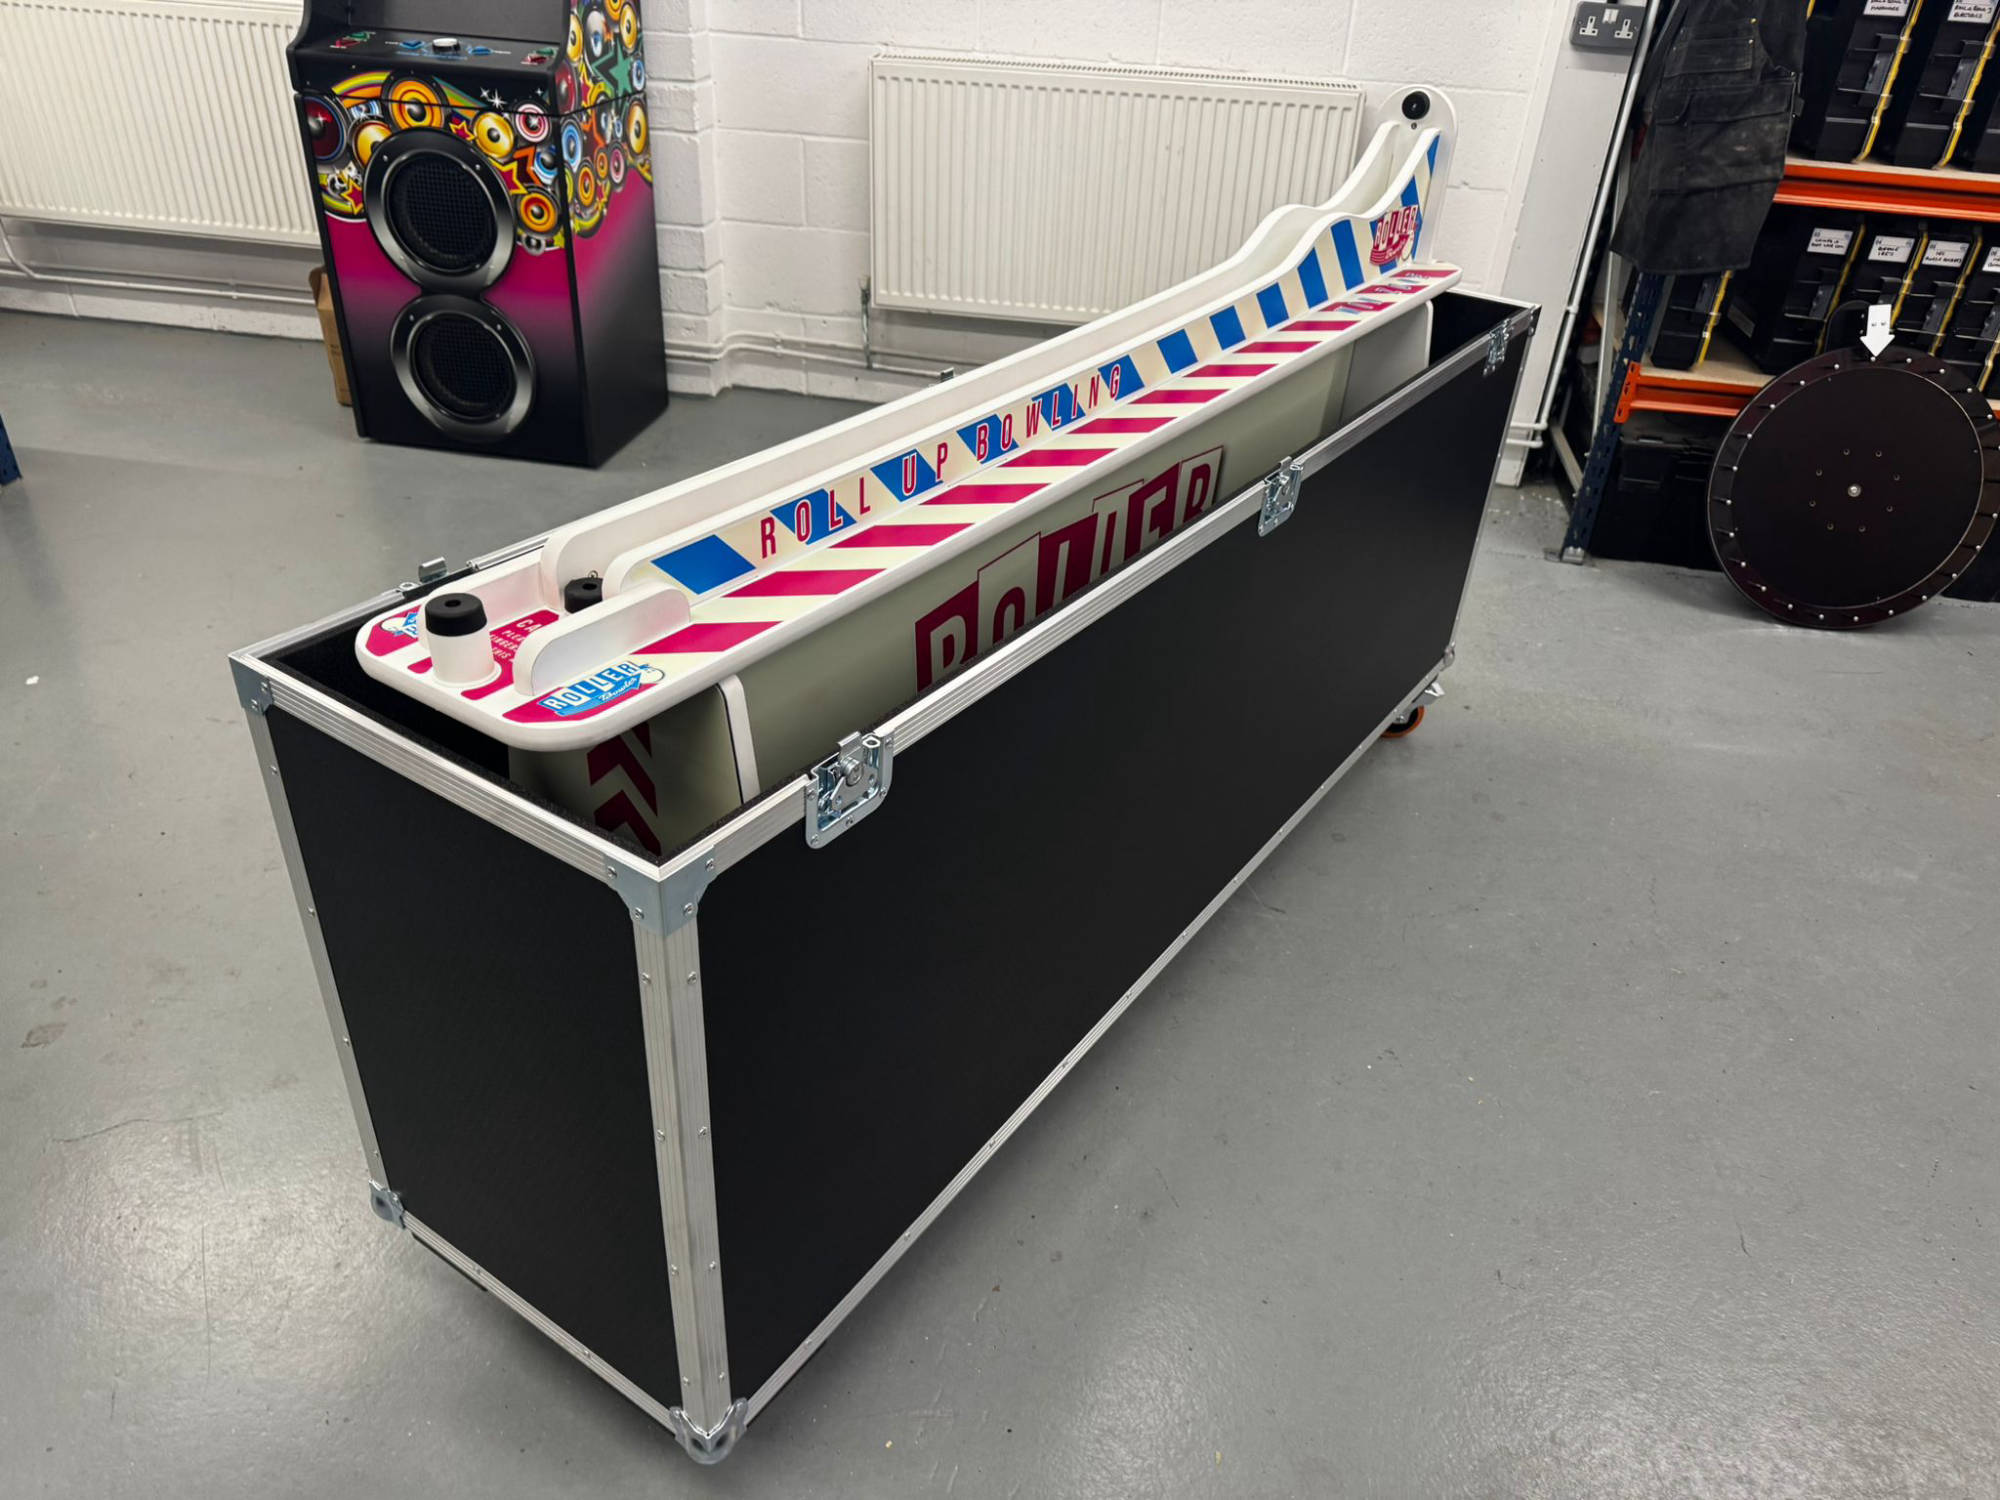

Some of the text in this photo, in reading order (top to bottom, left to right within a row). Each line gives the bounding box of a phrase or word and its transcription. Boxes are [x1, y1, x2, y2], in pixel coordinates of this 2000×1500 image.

[760, 364, 1121, 559] ROLL UP BOWLING
[541, 660, 640, 711] ROLLER
